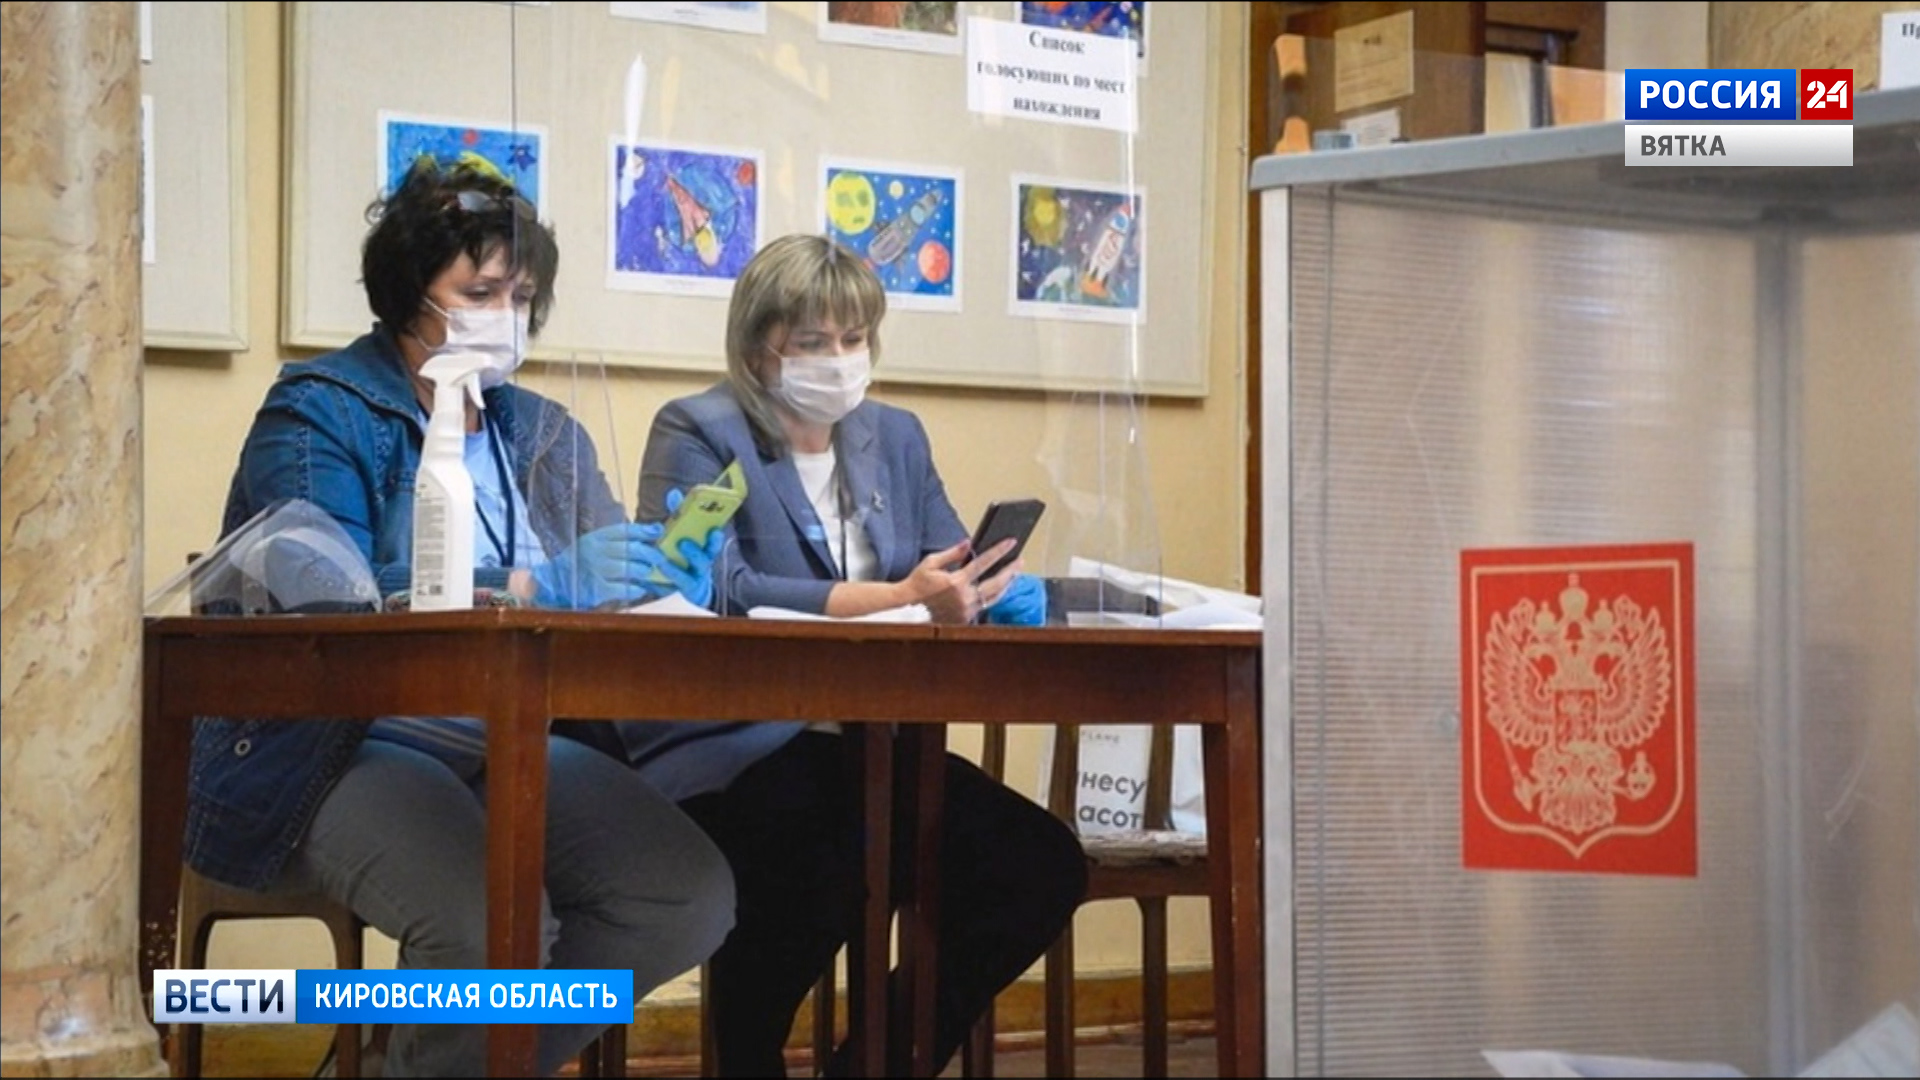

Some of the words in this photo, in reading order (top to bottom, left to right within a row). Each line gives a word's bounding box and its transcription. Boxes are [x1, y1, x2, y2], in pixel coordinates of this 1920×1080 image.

[1029, 30, 1085, 54] Список
[1073, 75, 1091, 88] по
[1013, 98, 1101, 120] нахождения
